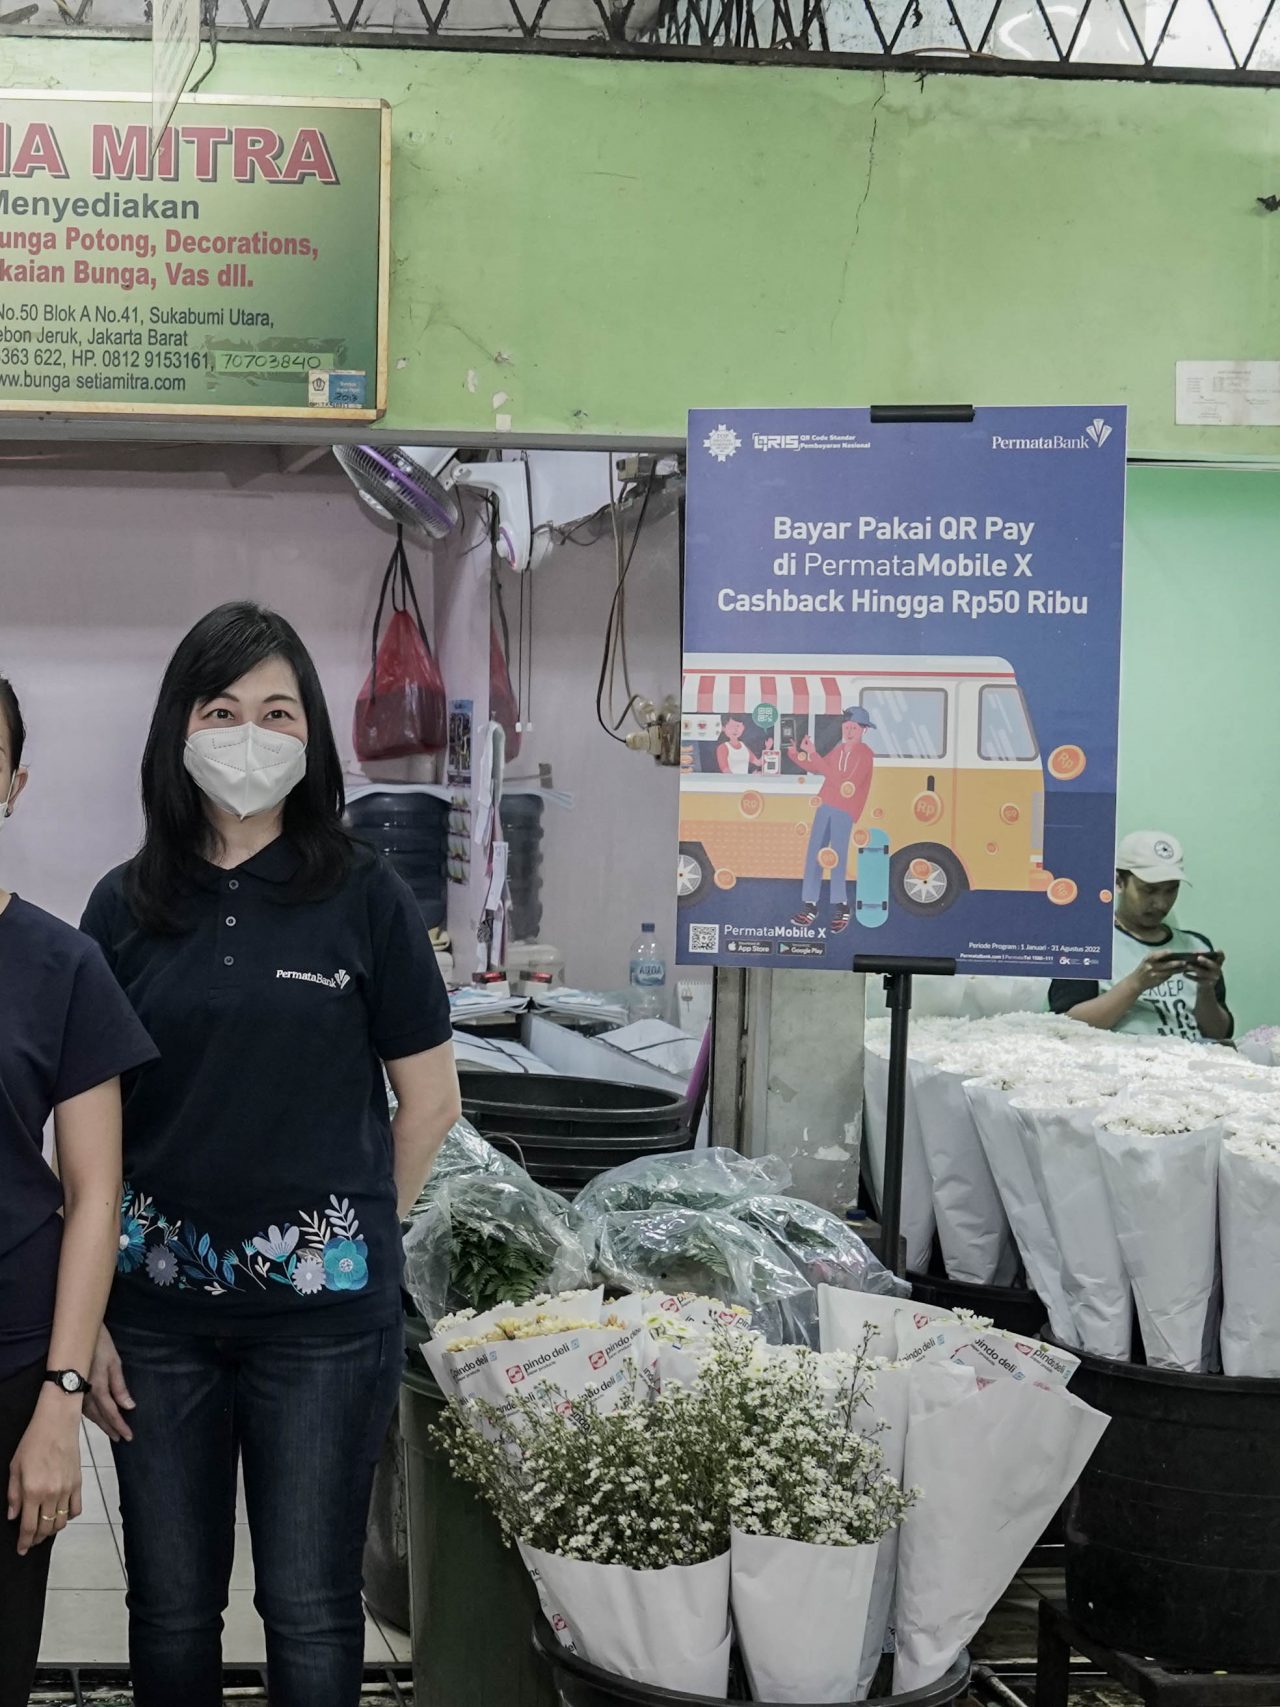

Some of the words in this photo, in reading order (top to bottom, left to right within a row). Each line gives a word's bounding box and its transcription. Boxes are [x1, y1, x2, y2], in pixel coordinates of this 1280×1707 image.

[91, 123, 340, 185] MITRA
[66, 226, 157, 258] Potong,
[165, 229, 319, 261] Decorations,
[74, 260, 157, 290] Bunga,
[165, 262, 210, 287] Vas
[217, 263, 253, 288] dll.
[43, 304, 76, 322] Blok
[79, 305, 91, 322] A
[95, 306, 144, 326] No.41,
[149, 307, 224, 326] Sukabumi
[229, 308, 274, 328] Utara,
[36, 327, 82, 347] Jeruk,
[87, 328, 142, 346] Jakarta
[147, 329, 188, 347] Barat
[33, 348, 66, 368] 622,
[71, 349, 97, 367] HP.
[102, 350, 140, 369] 0812
[144, 350, 214, 371] 9153161,
[222, 354, 322, 370] 70703840
[76, 371, 186, 391] setiamitra.com
[752, 433, 800, 452] QRIS
[991, 435, 1090, 449] PermataBank
[773, 516, 852, 545] Bayar
[858, 516, 931, 540] Pakai
[939, 516, 978, 541] QR
[985, 517, 1035, 545] Pay
[773, 553, 796, 576] di
[804, 552, 1007, 577] PermataMobile
[1013, 554, 1033, 577] X
[717, 588, 845, 613] Cashback
[852, 589, 944, 619] Hingga
[952, 589, 1020, 619] Rp50
[1027, 589, 1089, 615] Ribu
[917, 801, 936, 817] Rp
[724, 924, 815, 938] PermataMobile
[817, 927, 827, 938] X
[791, 946, 811, 955] Google
[812, 947, 823, 955] Play
[992, 942, 1017, 951] Program
[1060, 945, 1083, 953] Agustus
[275, 969, 337, 988] PermataBank
[605, 1336, 630, 1356] pindo
[522, 1353, 552, 1373] pindo
[551, 1343, 570, 1359] deli
[998, 1355, 1016, 1374] deli
[600, 1377, 616, 1392] deli
